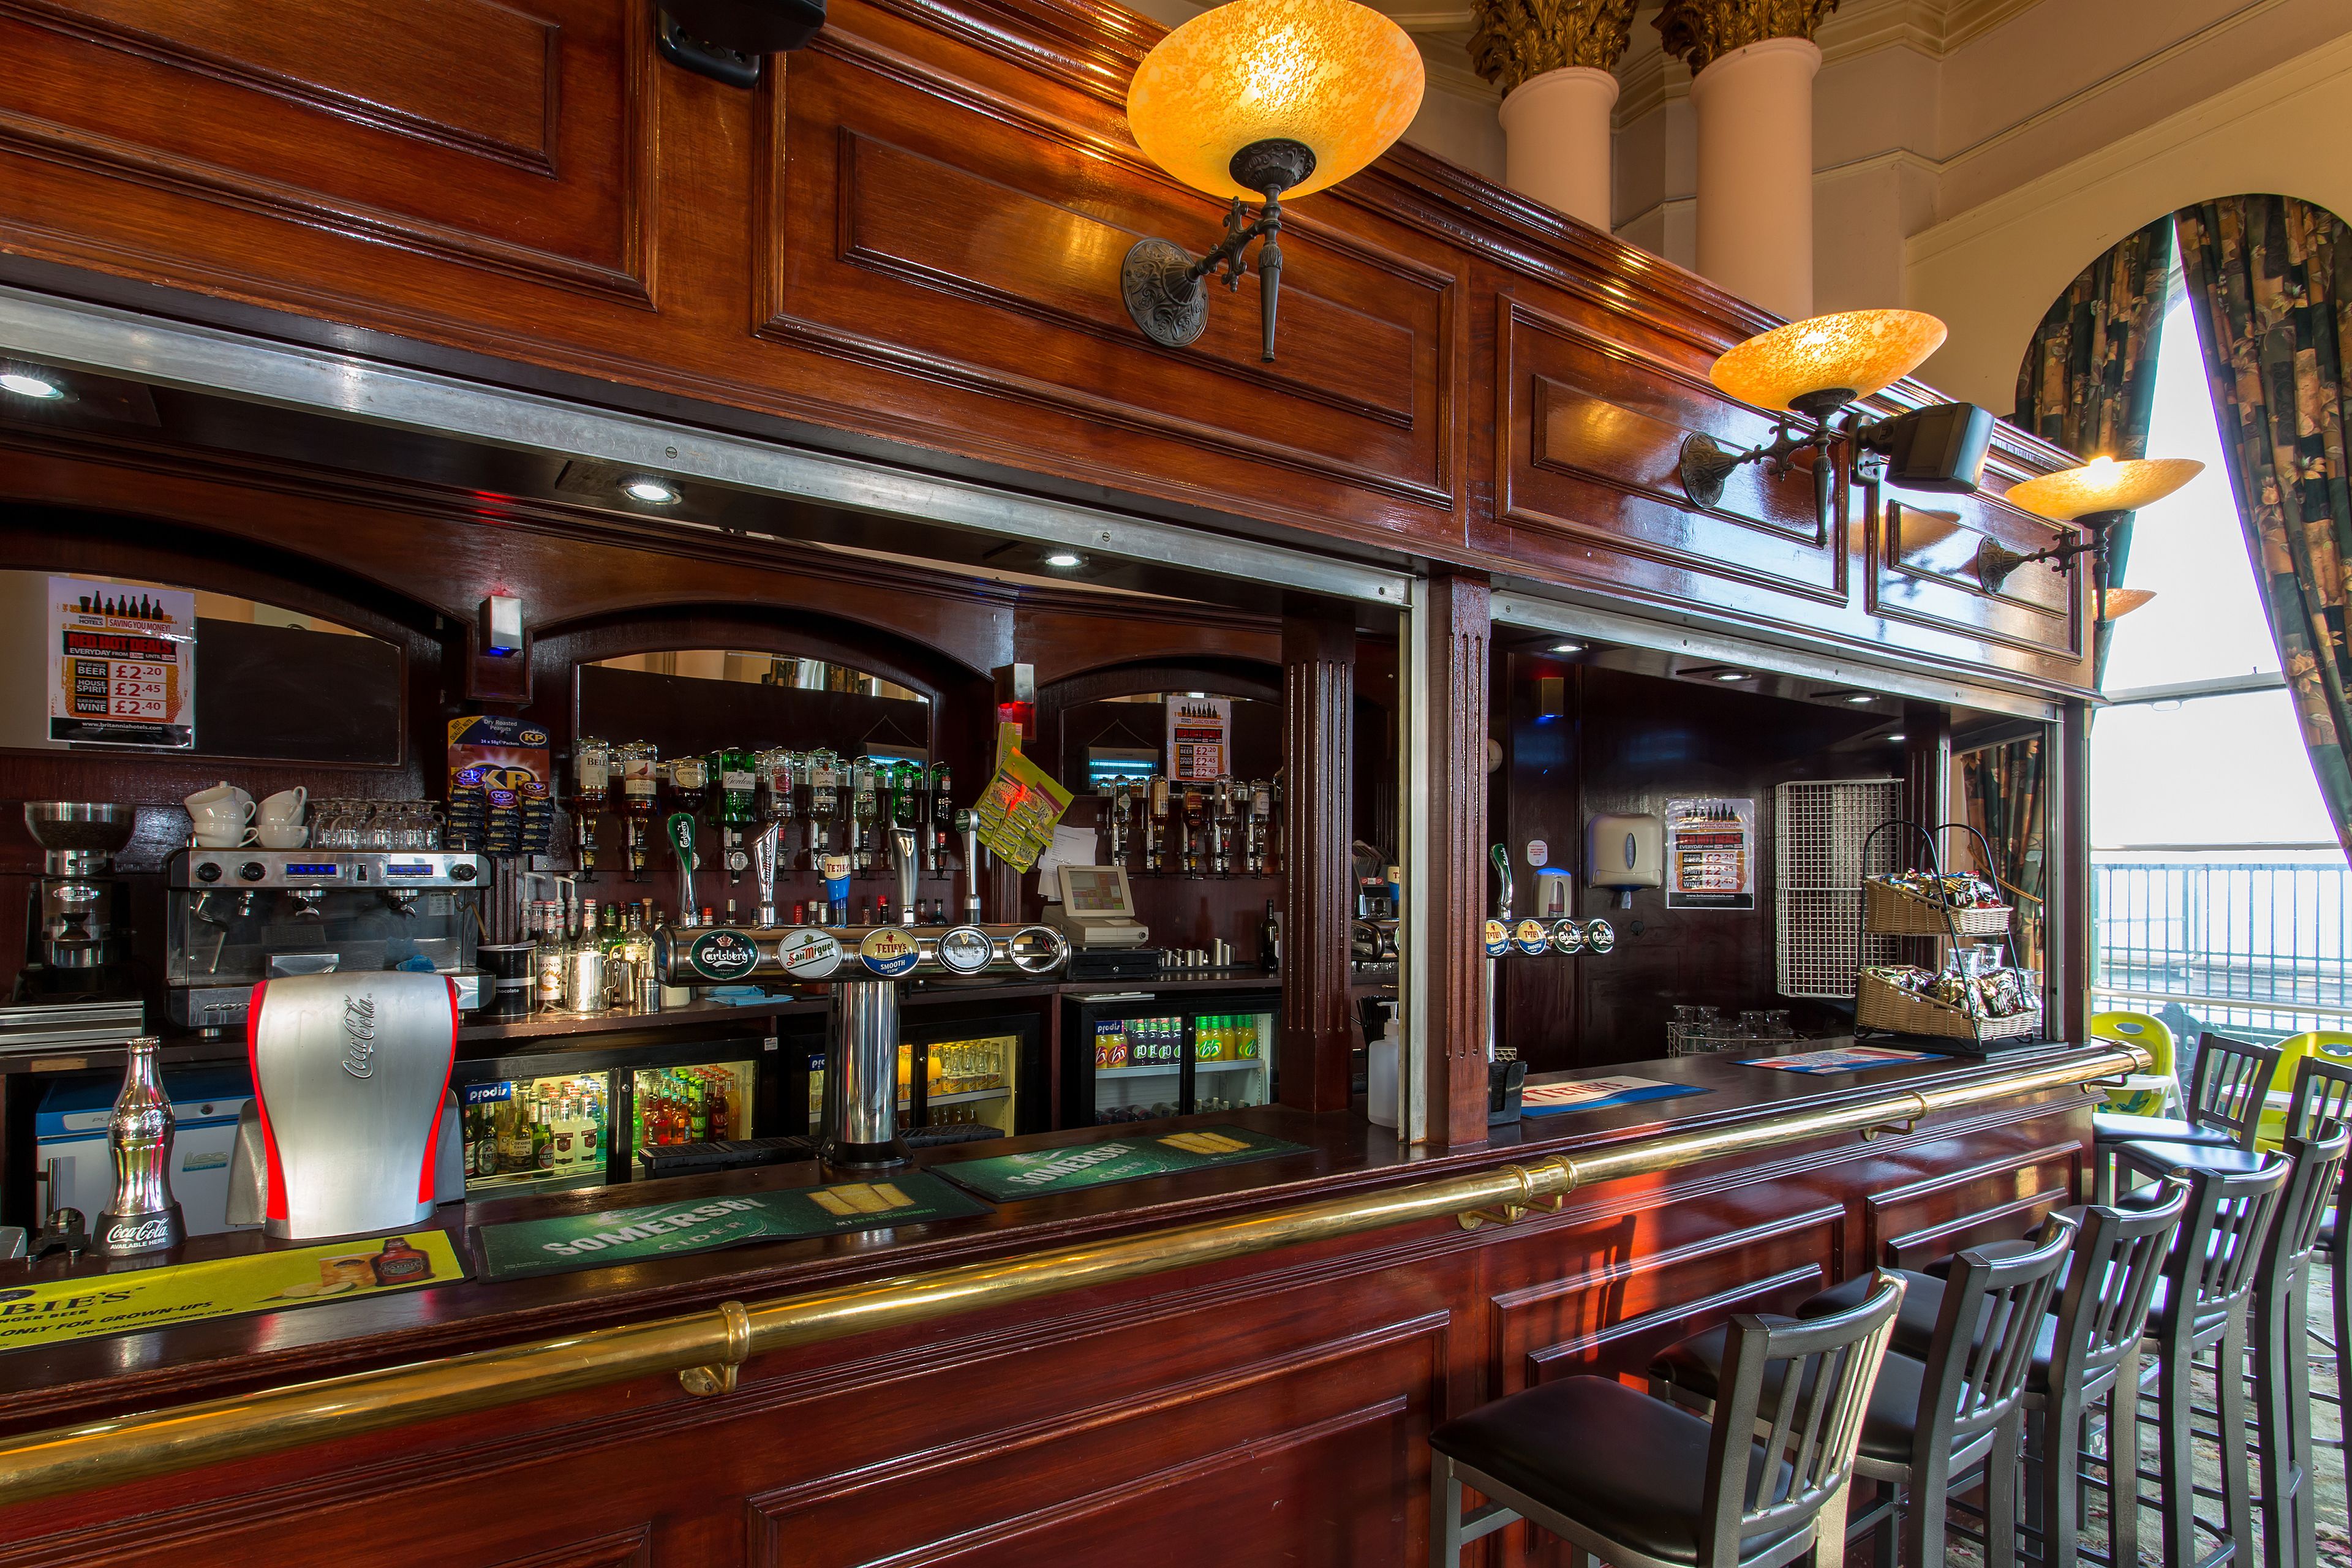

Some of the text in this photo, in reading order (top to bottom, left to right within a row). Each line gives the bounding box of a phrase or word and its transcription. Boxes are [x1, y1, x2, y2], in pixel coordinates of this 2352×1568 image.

[110, 619, 171, 632] SAVING YOU MONEY!
[68, 633, 172, 654] RED HOT DEALS
[78, 665, 162, 679] BEER £2.20
[115, 682, 161, 696] £2.45
[77, 701, 161, 715] WINE £2.40
[82, 721, 163, 731] www.britanniahotels.com
[450, 718, 473, 741] QUALITY NUTS
[451, 720, 461, 730] BEST
[524, 733, 544, 742] KP
[1196, 747, 1216, 755] £2.20
[482, 769, 531, 790] KP
[725, 774, 755, 785] Gordon's
[679, 821, 690, 848] Carlsberg
[1697, 835, 1714, 844] HOT
[1714, 834, 1741, 843] DEALS
[1558, 931, 1581, 944] Carlsberg
[1593, 931, 1613, 944] Carlsberg
[786, 941, 834, 967] San Miguel
[875, 942, 907, 954] TETLEY'S
[943, 945, 987, 956] GUINNESS
[701, 946, 749, 967] Carlsberg
[880, 959, 905, 970] SMOOTH
[1098, 1023, 1120, 1035] prodis
[342, 994, 375, 1079] Coca-Cola
[470, 1083, 508, 1102] prodis
[692, 1118, 703, 1126] VK
[1007, 1142, 1136, 1185] SOMERSBY
[1098, 1161, 1146, 1180] CIDER
[878, 1208, 937, 1220] REFRESHMENT
[107, 1217, 170, 1243] Coca-Cola
[543, 1198, 768, 1256] SOMERSBY
[149, 1237, 167, 1246] HERE
[659, 1222, 745, 1251] CIDER
[1, 1301, 214, 1336] ONLY FOR GROWN-UPS
[49, 1310, 89, 1318] BEER
